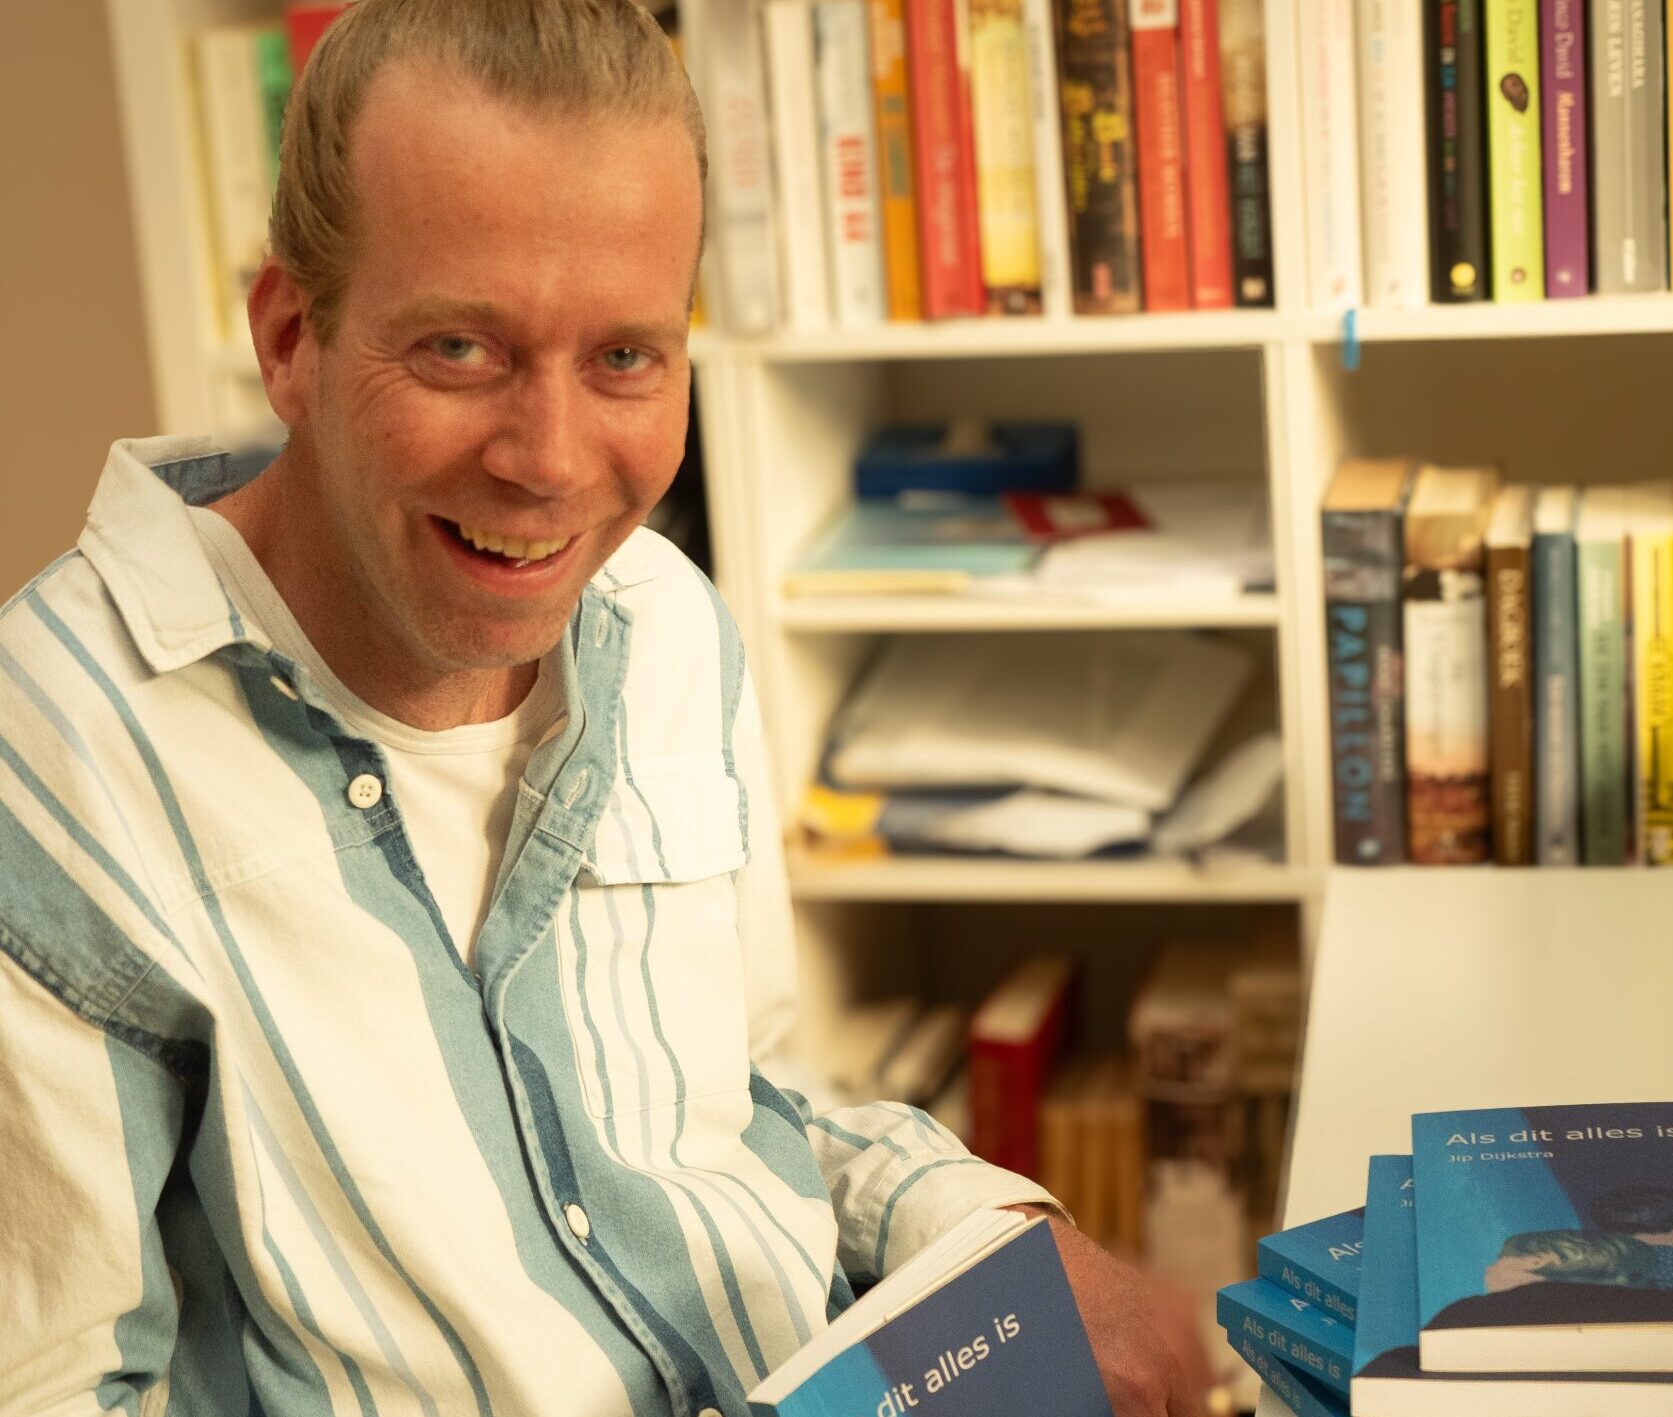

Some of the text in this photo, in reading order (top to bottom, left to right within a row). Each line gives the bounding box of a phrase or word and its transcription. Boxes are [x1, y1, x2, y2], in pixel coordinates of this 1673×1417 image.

[1334, 605, 1374, 823] PAPILLON
[1446, 1132, 1497, 1146] Als
[1509, 1129, 1554, 1143] dit
[1566, 1126, 1645, 1141] alles
[1282, 1266, 1300, 1290] Als
[1304, 1282, 1322, 1302] dit
[1324, 1294, 1356, 1321] alles
[877, 1312, 1021, 1417] dit alles is
[1243, 1316, 1342, 1380] Als dit alles is
